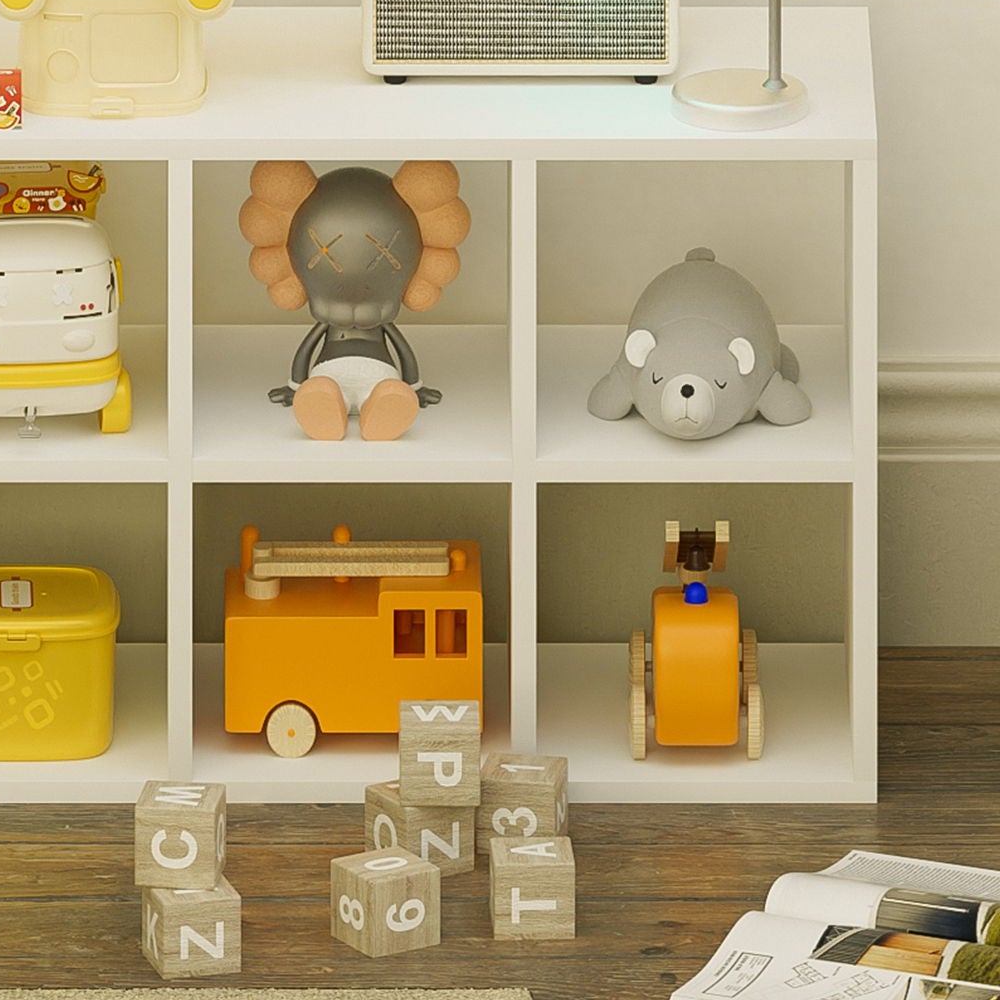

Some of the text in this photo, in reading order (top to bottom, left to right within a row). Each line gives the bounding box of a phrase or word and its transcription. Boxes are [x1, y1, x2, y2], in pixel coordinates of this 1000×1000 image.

[417, 752, 462, 787] P
[492, 807, 537, 837] 3
[151, 829, 198, 869] C
[510, 842, 557, 858] A
[339, 894, 364, 930] 8
[386, 898, 425, 932] 6
[511, 887, 557, 924] T
[147, 903, 159, 960] K
